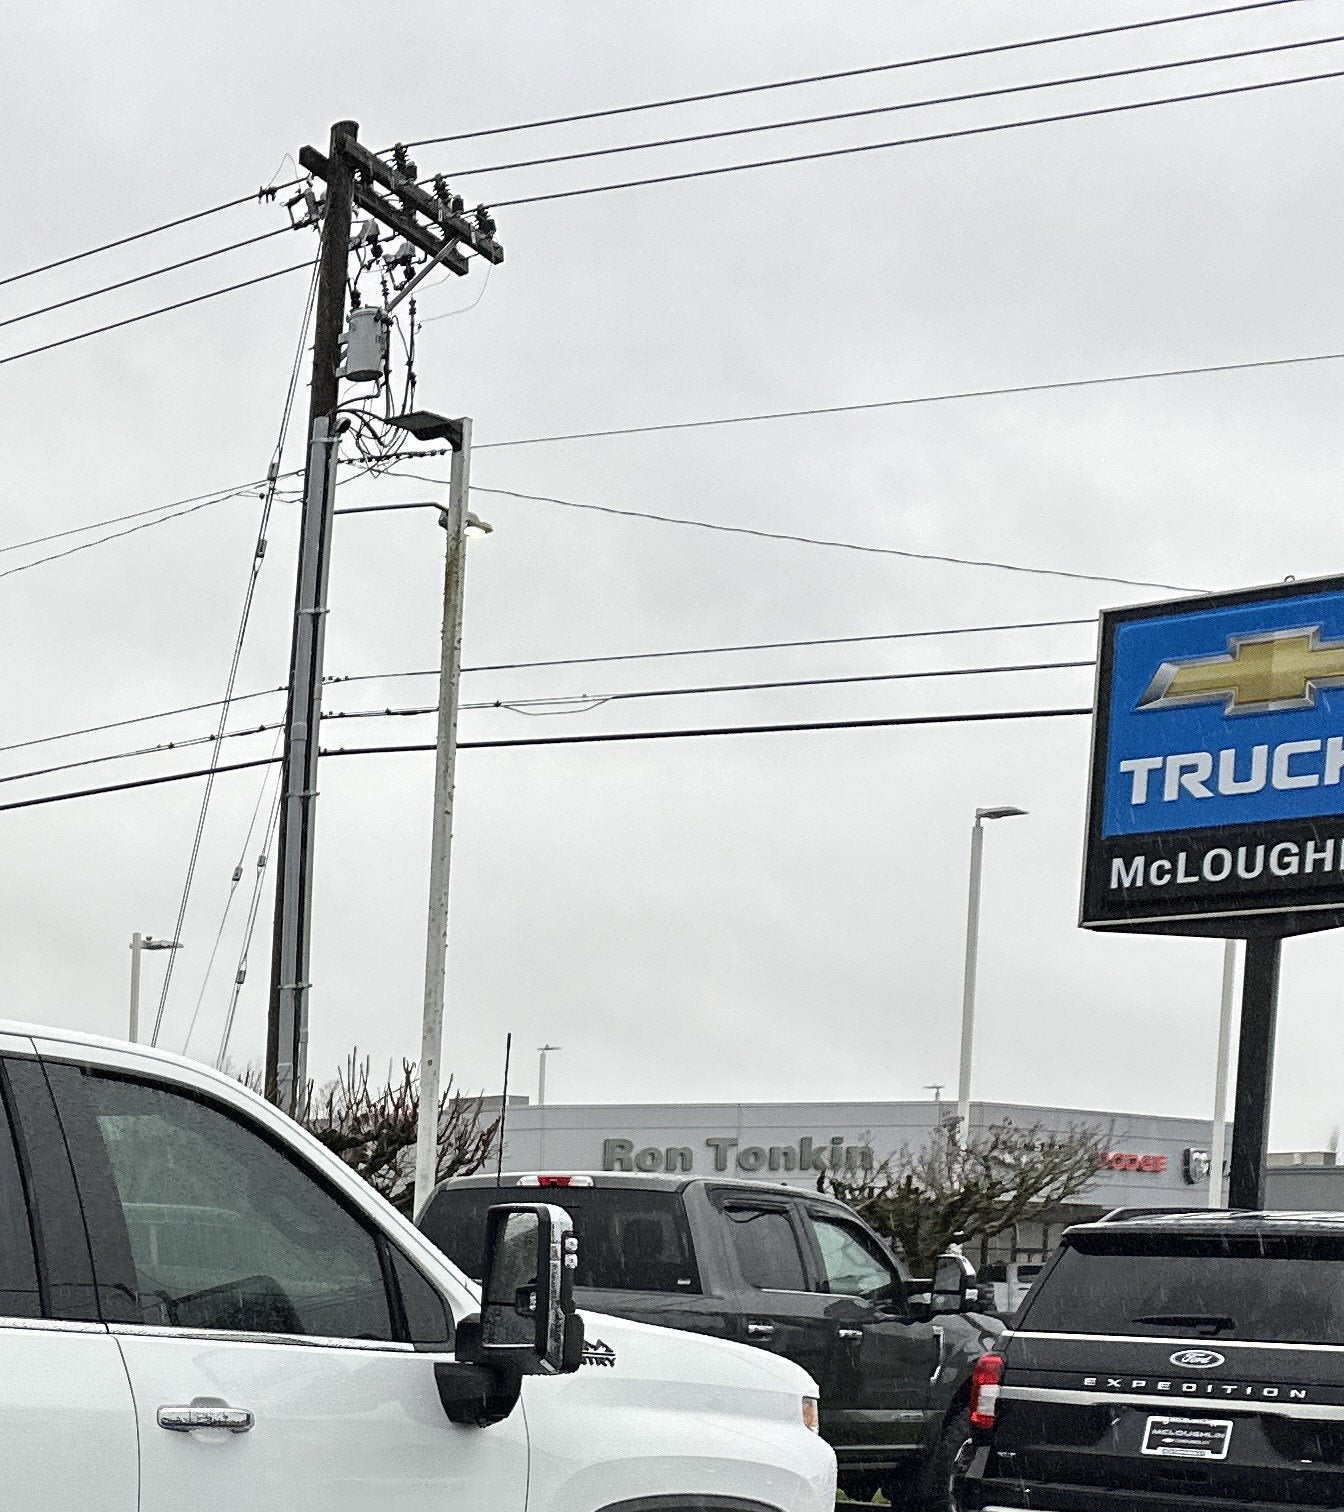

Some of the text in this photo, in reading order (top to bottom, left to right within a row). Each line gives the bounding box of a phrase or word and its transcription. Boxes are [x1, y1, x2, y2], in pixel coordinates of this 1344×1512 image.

[603, 1136, 874, 1171] Ron Tonkin
[1084, 1377, 1306, 1399] EXPEDITION
